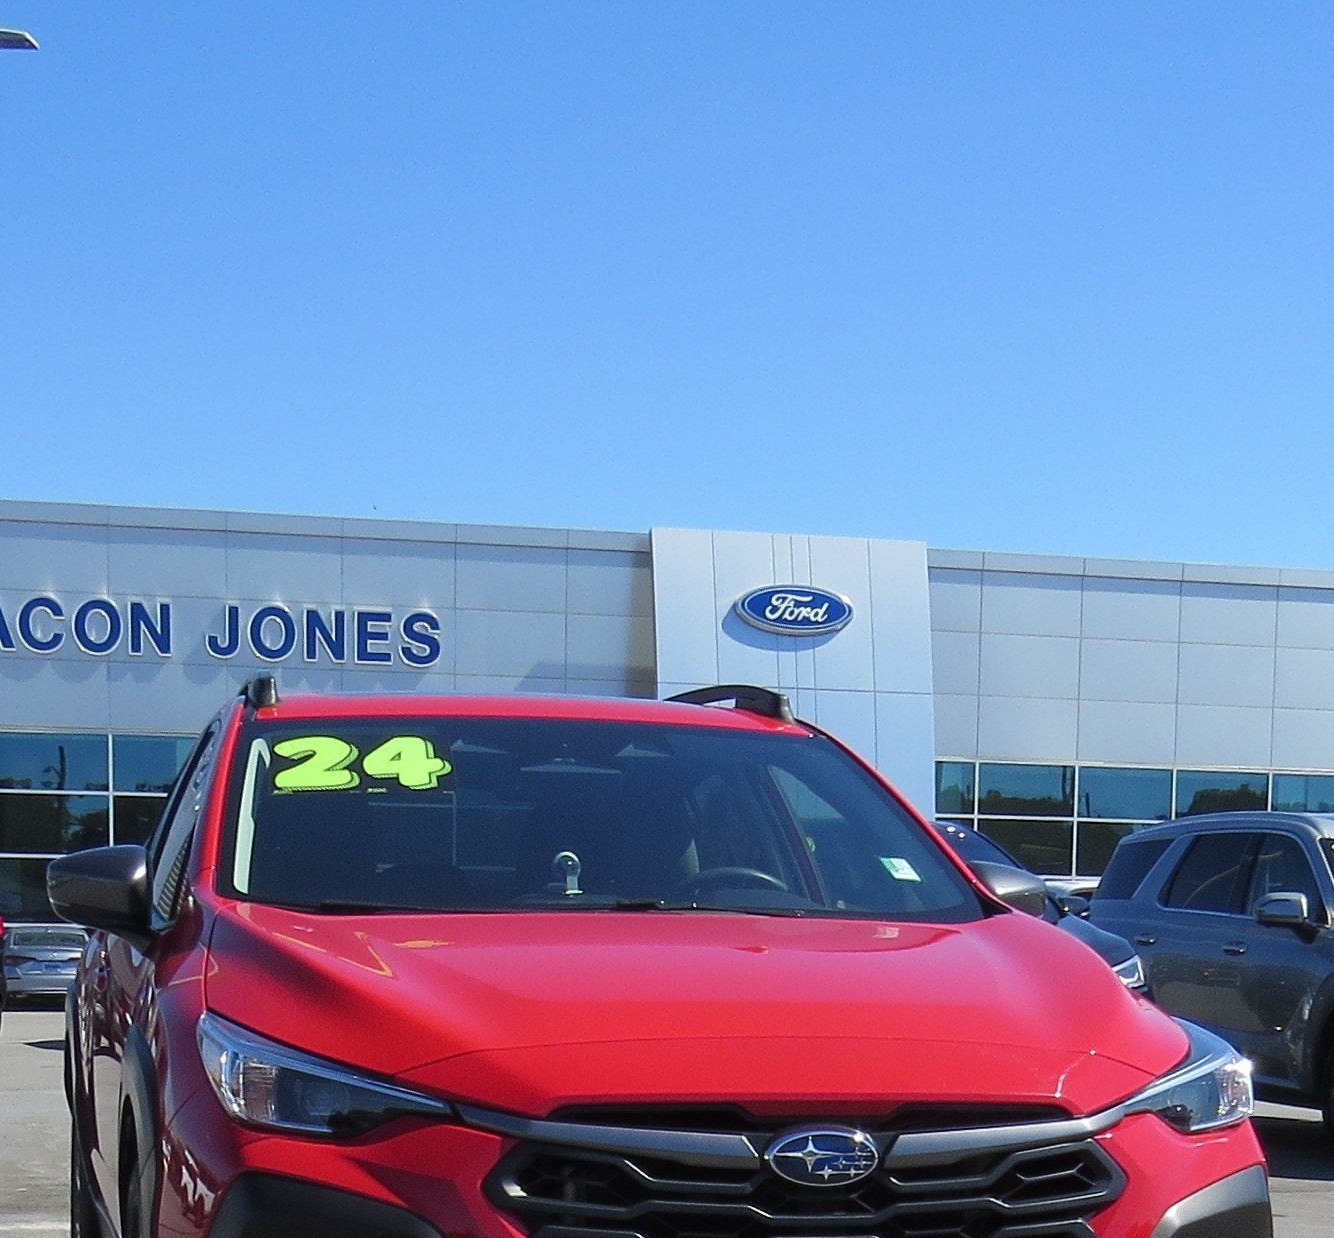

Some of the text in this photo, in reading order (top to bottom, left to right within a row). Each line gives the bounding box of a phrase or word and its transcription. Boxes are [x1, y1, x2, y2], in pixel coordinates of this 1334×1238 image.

[206, 602, 441, 667] JONES
[765, 593, 829, 622] Ford
[273, 735, 453, 791] 24
